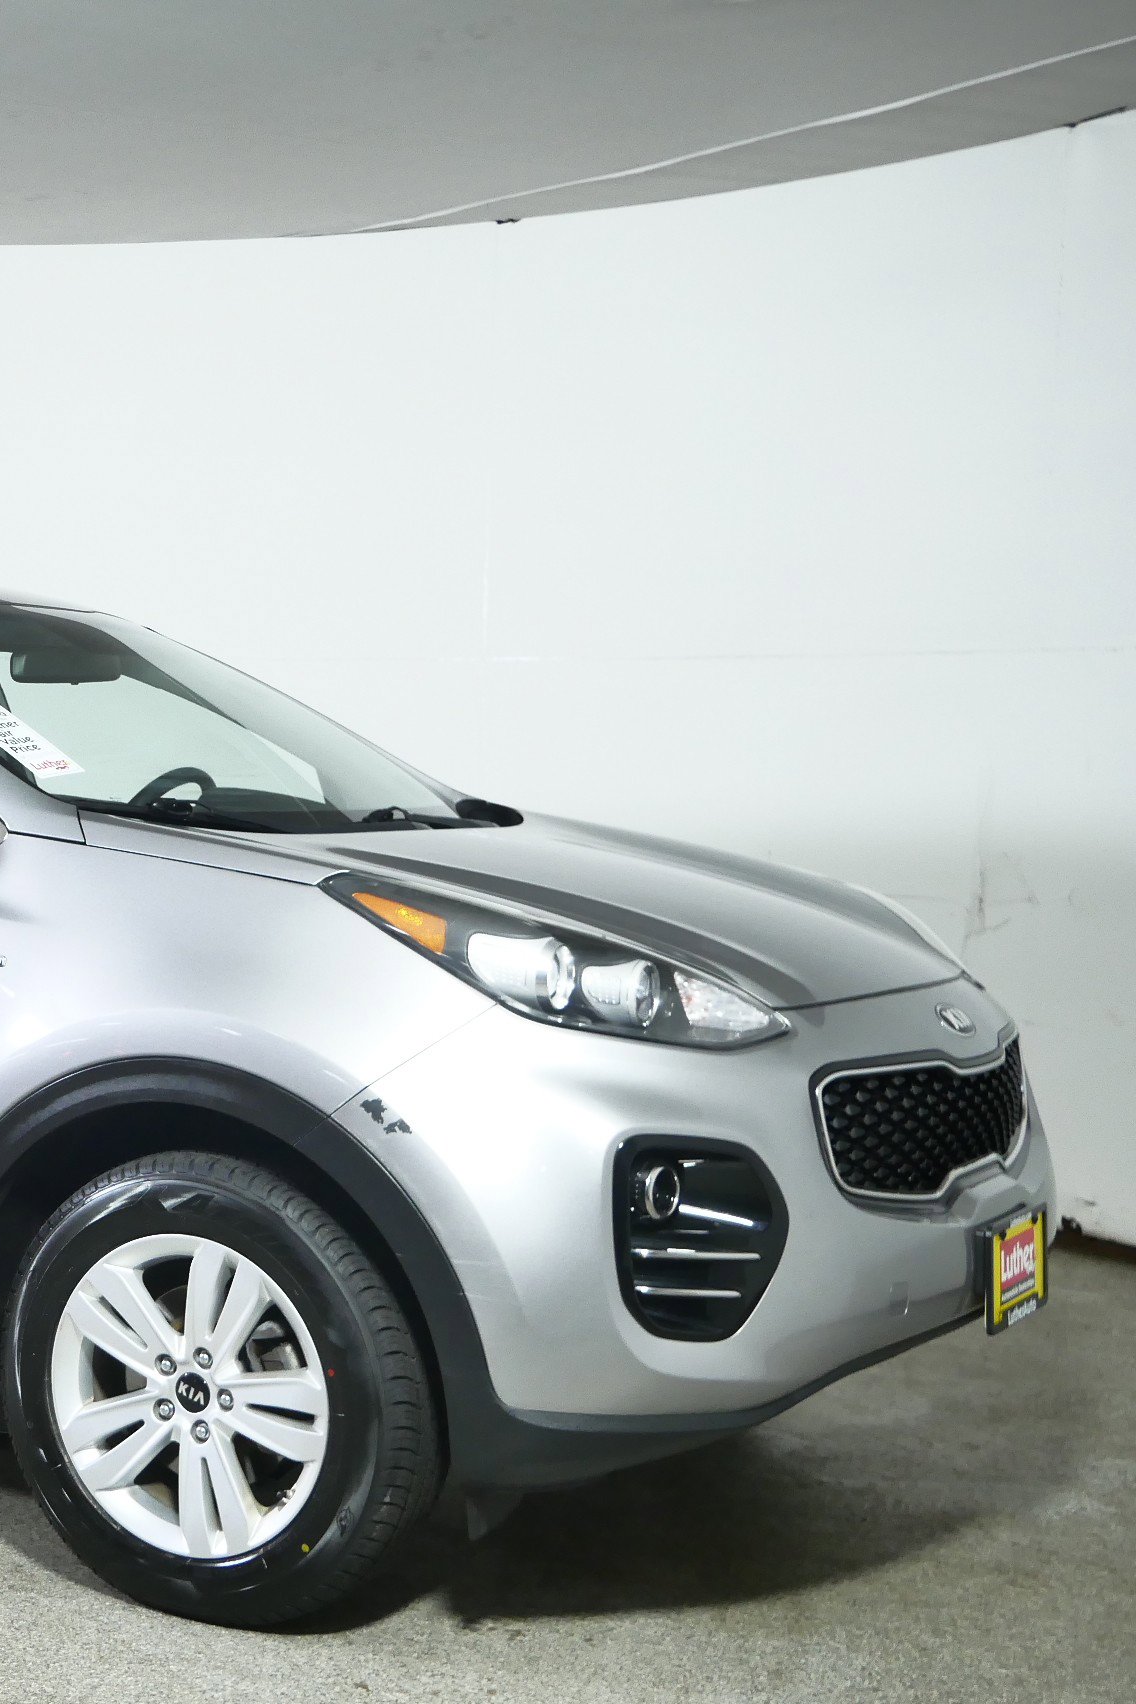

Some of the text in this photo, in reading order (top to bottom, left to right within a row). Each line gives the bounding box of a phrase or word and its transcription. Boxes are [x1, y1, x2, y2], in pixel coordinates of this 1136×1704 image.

[0, 736, 35, 745] Value
[9, 744, 42, 754] Price
[30, 759, 69, 770] Luther
[1001, 1240, 1035, 1283] Luther
[178, 1380, 205, 1406] KIA
